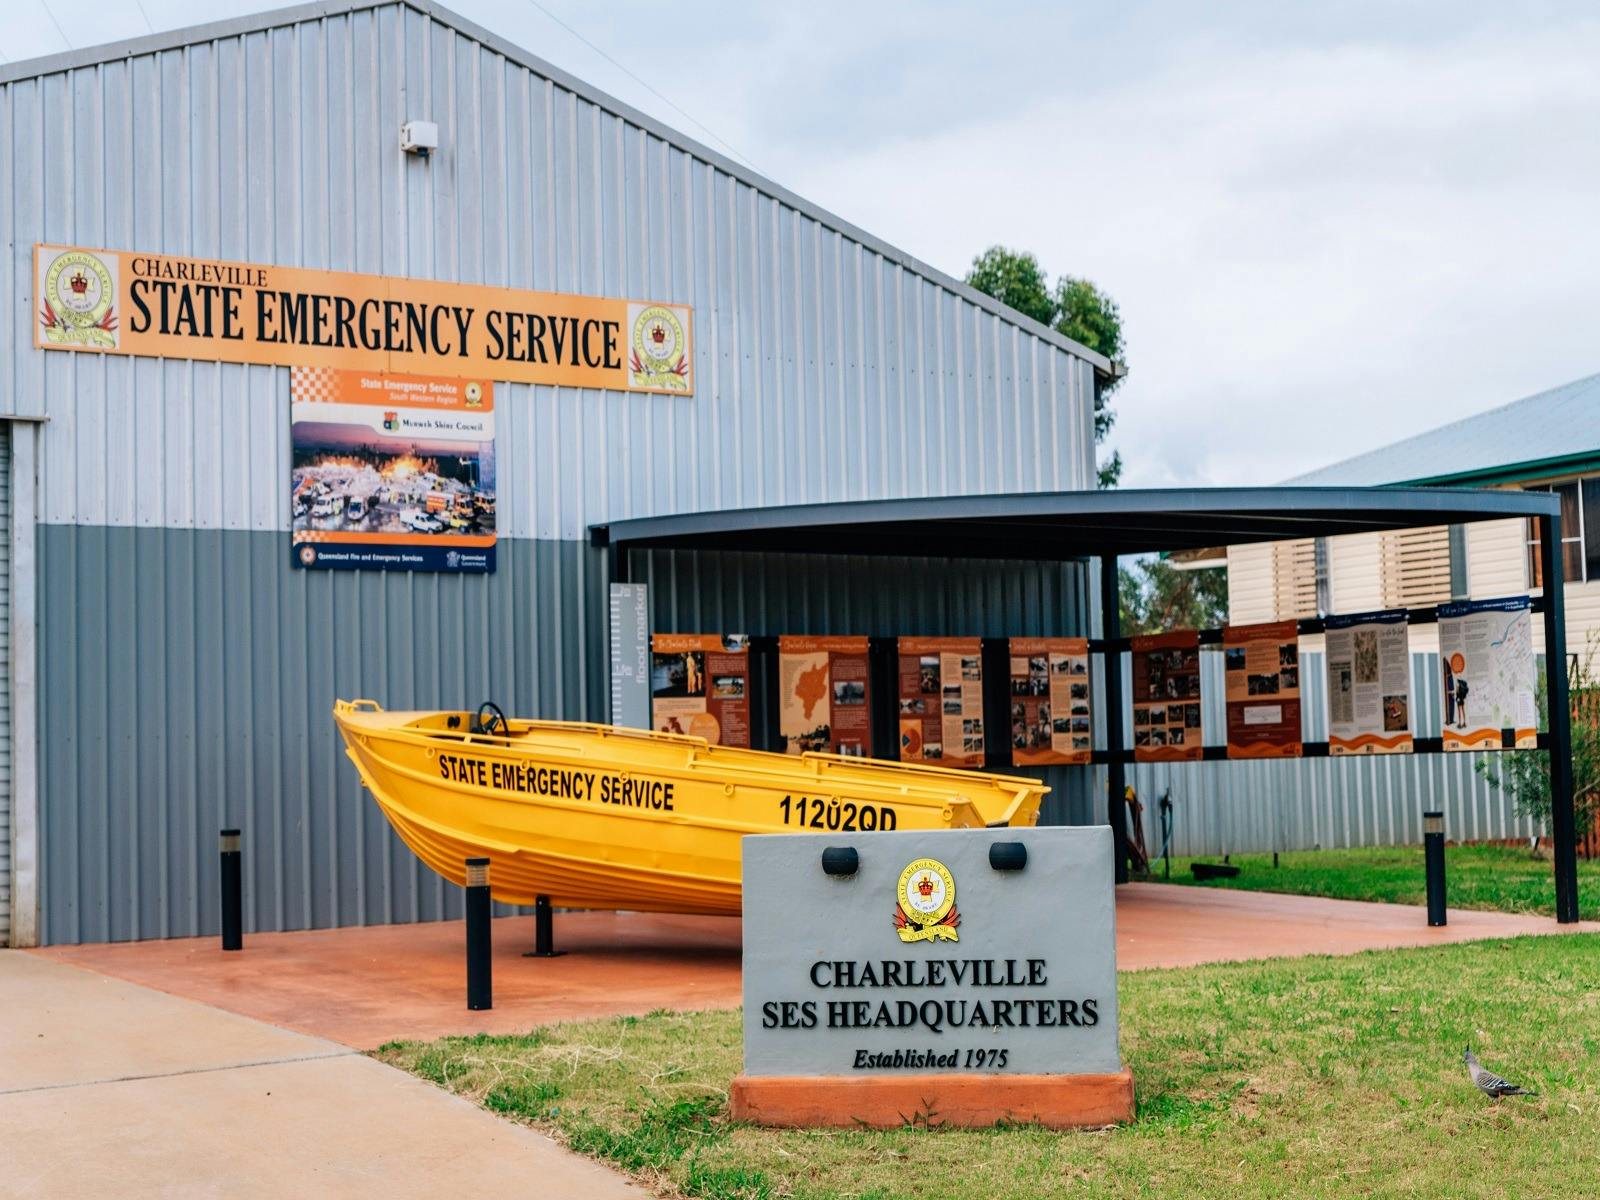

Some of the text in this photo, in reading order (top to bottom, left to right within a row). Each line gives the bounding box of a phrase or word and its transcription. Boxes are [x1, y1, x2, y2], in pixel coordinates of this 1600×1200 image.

[131, 258, 267, 287] CHARLEVILLE
[130, 279, 621, 370] STATE EMERGENCY SERVICE
[360, 377, 458, 394] State Emergency Service
[434, 420, 453, 429] Shire
[456, 422, 483, 431] Council
[318, 552, 424, 563] Queensland Fire and Emergency Services
[634, 585, 646, 683] flood marker
[439, 754, 674, 811] STATE EMERGENCY SERVICE
[779, 794, 897, 832] 11202QD
[809, 959, 1047, 988] CHARLEVILLE
[762, 998, 1099, 1033] SES HEADQUARTERS
[852, 1049, 1008, 1069] Established 1975
